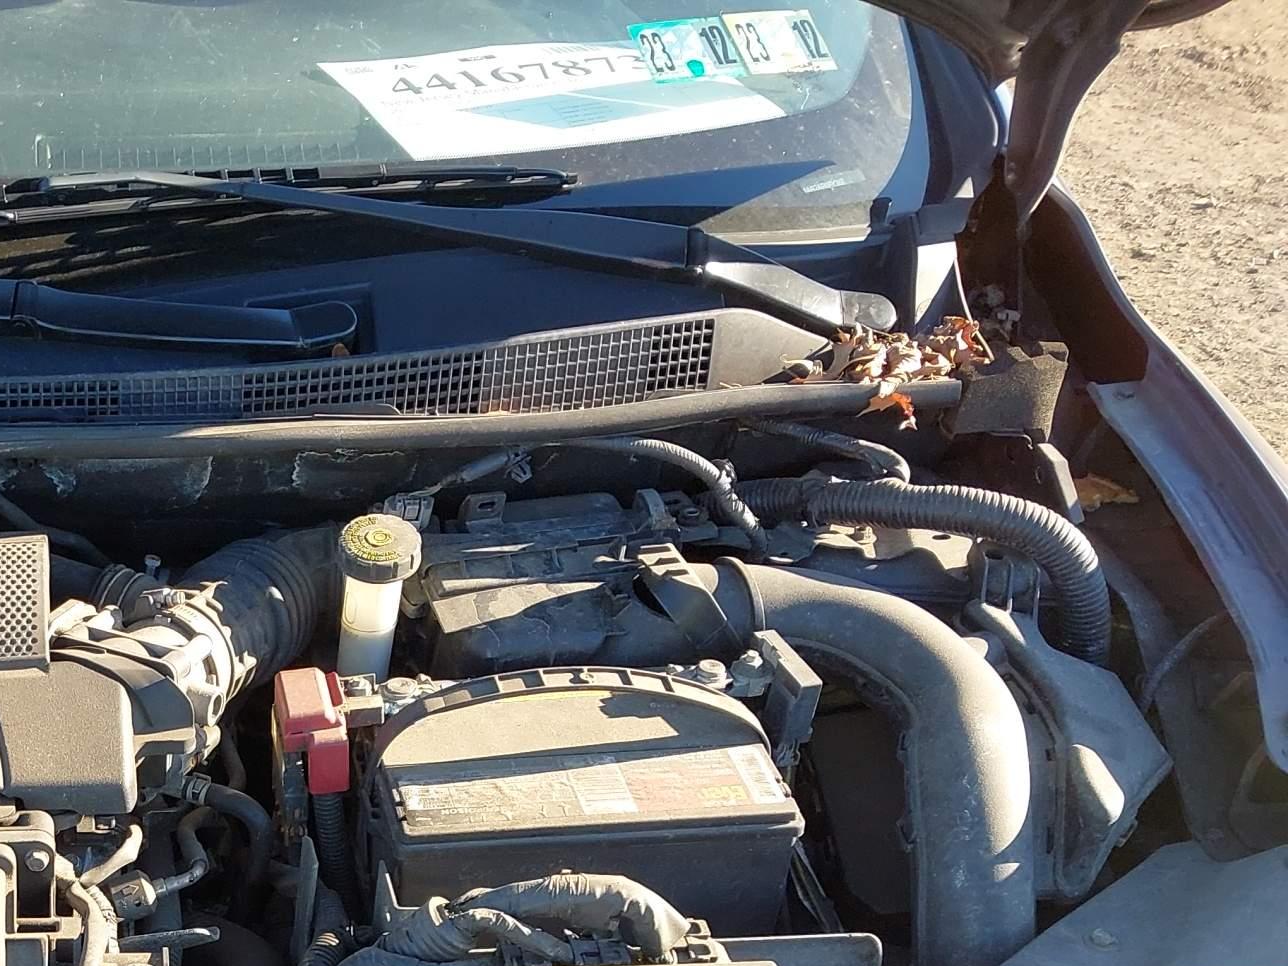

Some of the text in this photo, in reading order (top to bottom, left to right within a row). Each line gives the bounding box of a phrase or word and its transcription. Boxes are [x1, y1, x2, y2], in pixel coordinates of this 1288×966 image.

[640, 25, 738, 73] 23 12
[735, 19, 829, 63] 23 12
